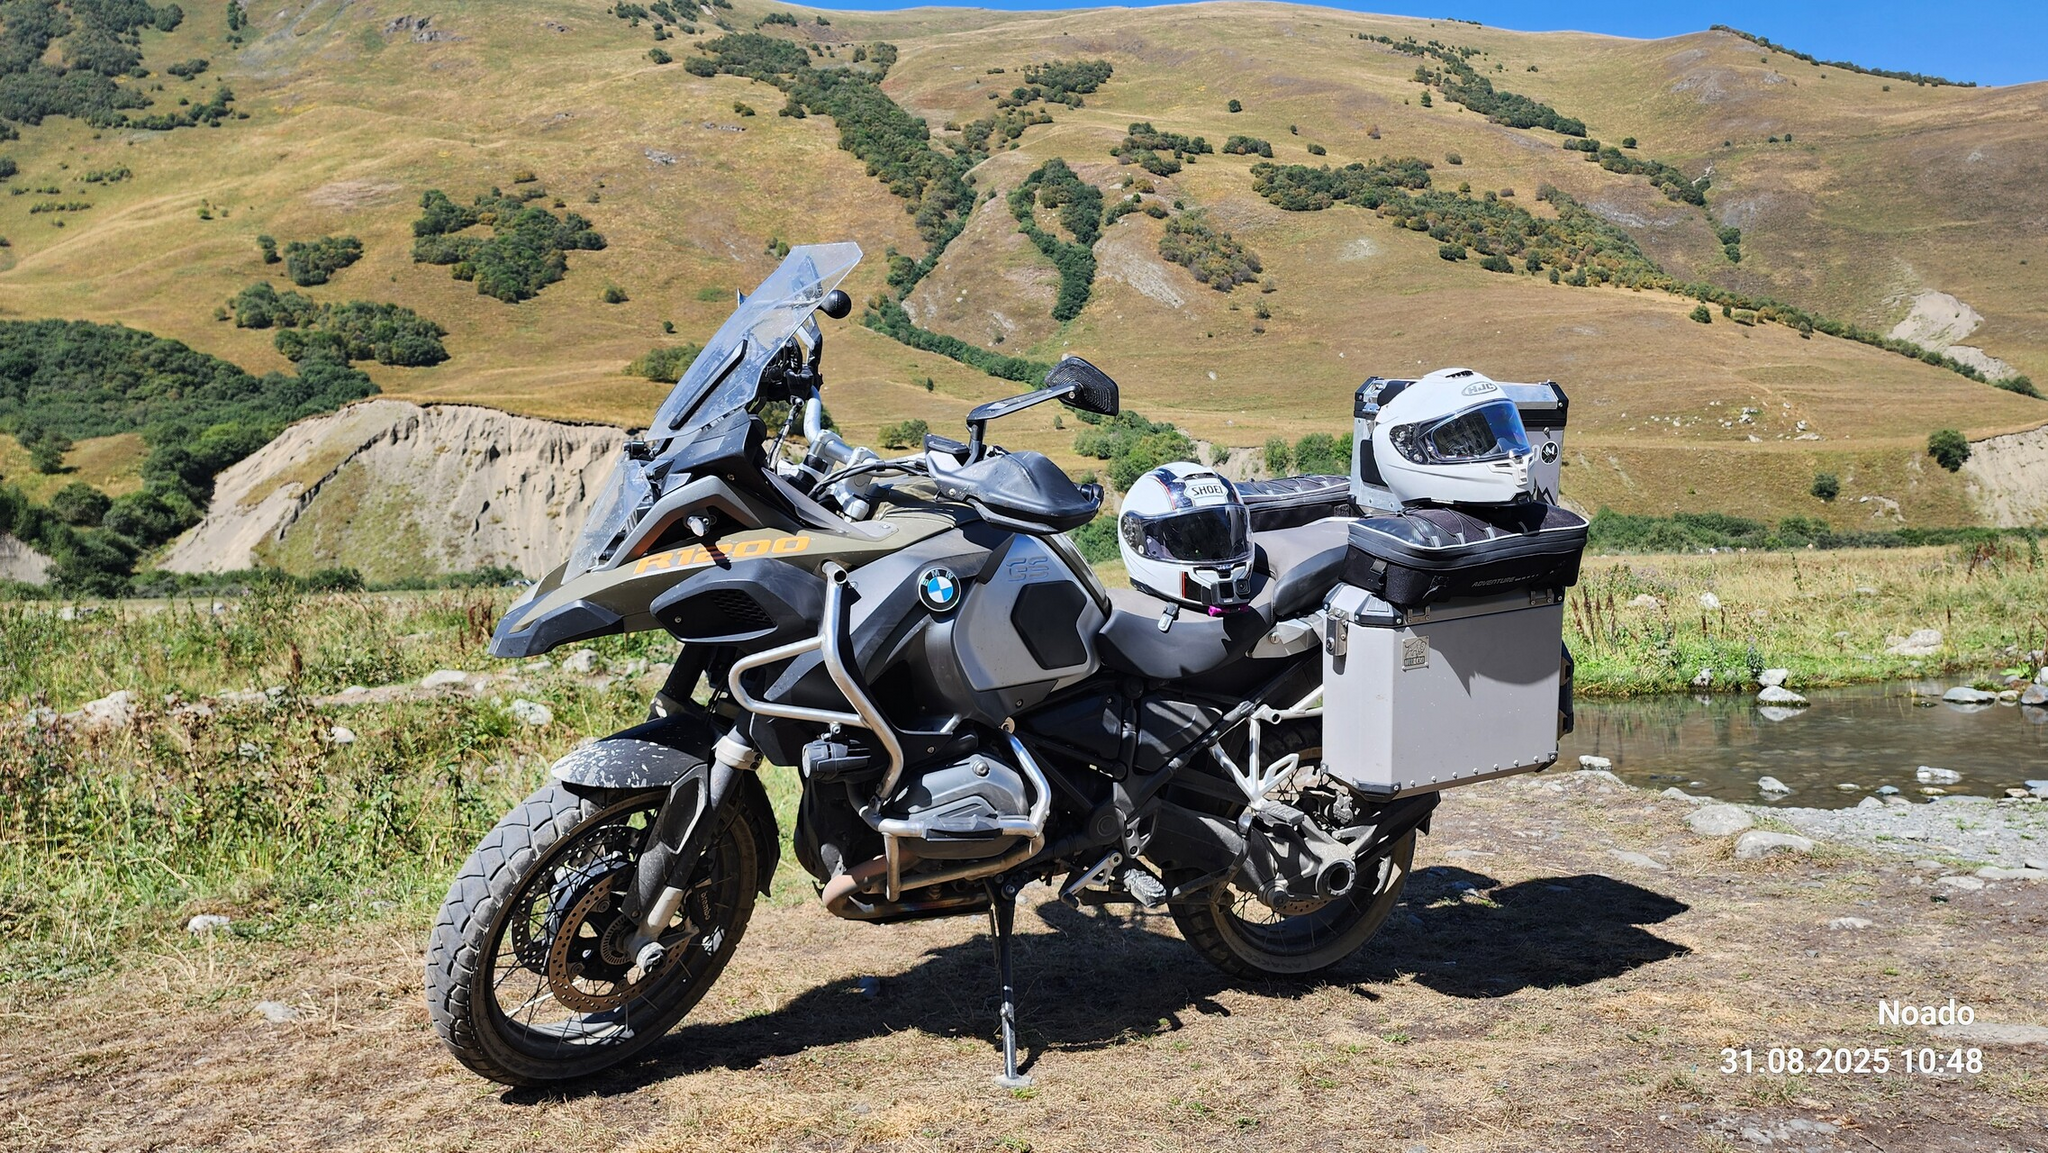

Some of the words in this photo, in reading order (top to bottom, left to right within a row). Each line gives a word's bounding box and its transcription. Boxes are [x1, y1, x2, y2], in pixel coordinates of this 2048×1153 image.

[1467, 383, 1494, 394] HJC
[1191, 485, 1223, 496] SHOEI
[633, 536, 811, 575] R1200
[1006, 556, 1049, 582] GS
[921, 569, 954, 586] BMW
[1471, 576, 1515, 587] ADVENTURE
